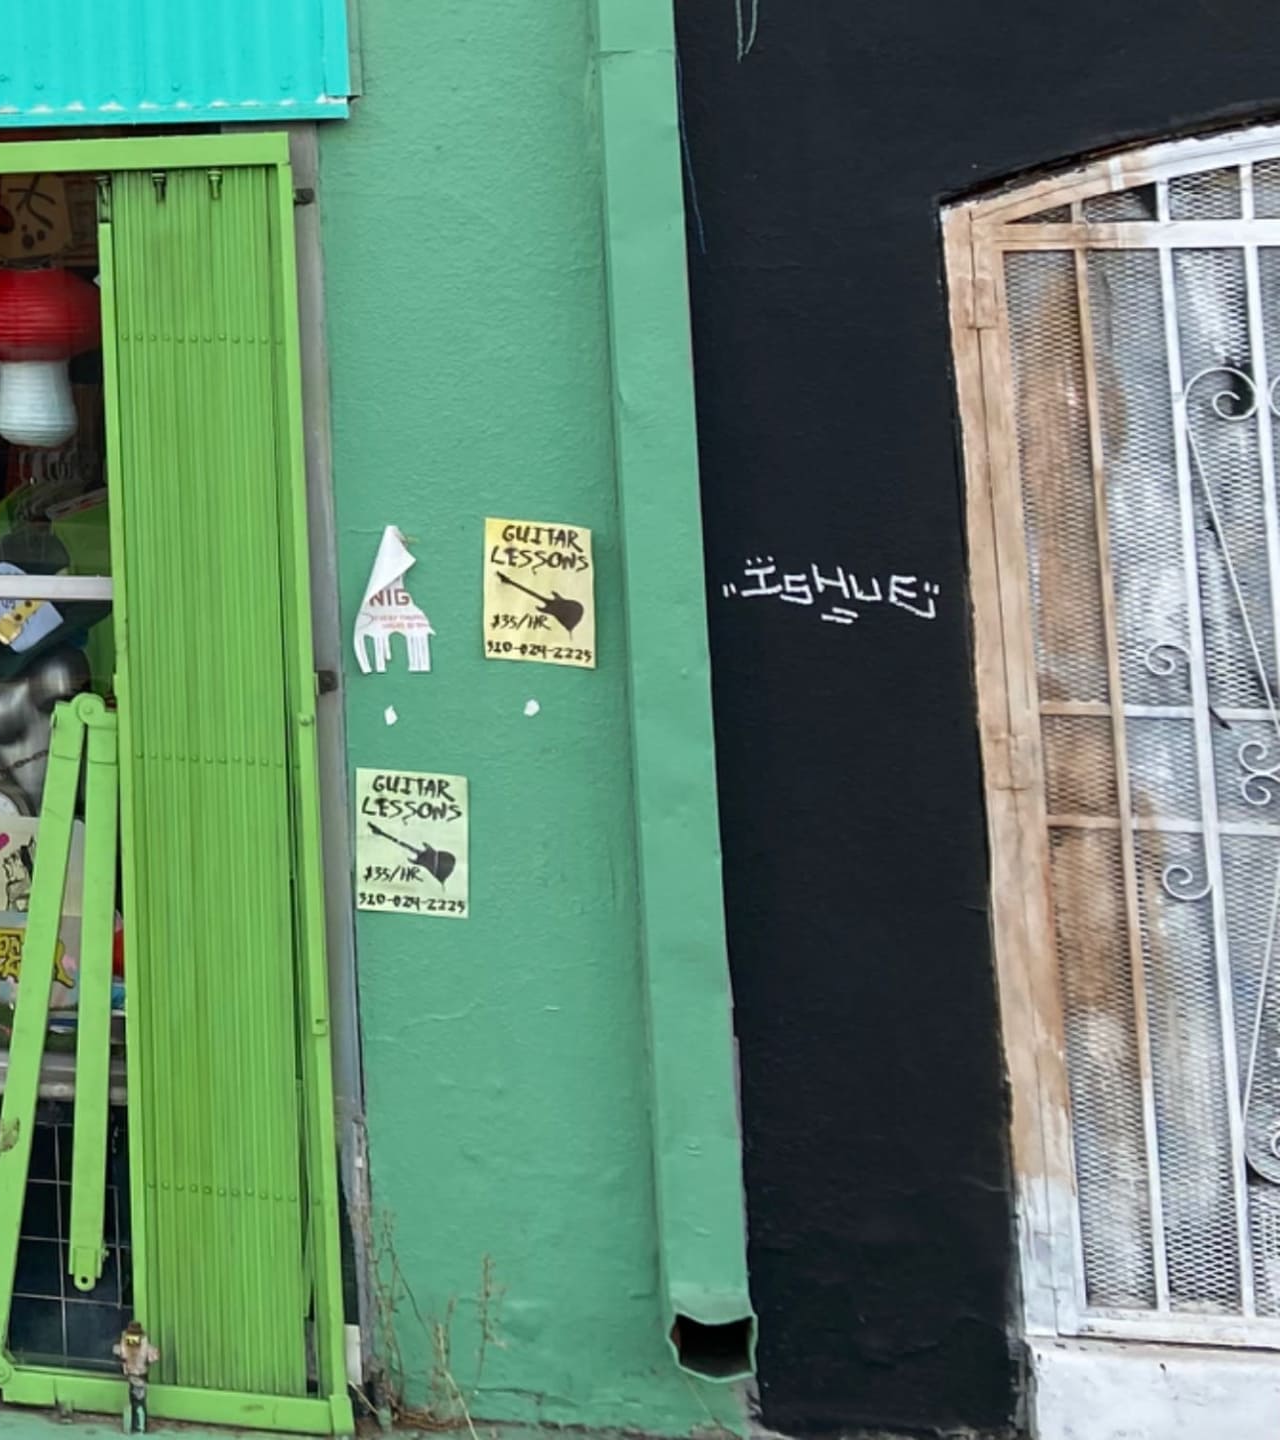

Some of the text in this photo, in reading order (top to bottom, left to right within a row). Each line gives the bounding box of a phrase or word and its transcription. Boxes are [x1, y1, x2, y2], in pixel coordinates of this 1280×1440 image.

[502, 525, 583, 553] GUITAR
[491, 545, 589, 575] LESSONS
[491, 613, 552, 631] $35/HR
[372, 775, 455, 802] GUITAR
[362, 796, 462, 825] LESSONS
[364, 865, 424, 882] $35/HR
